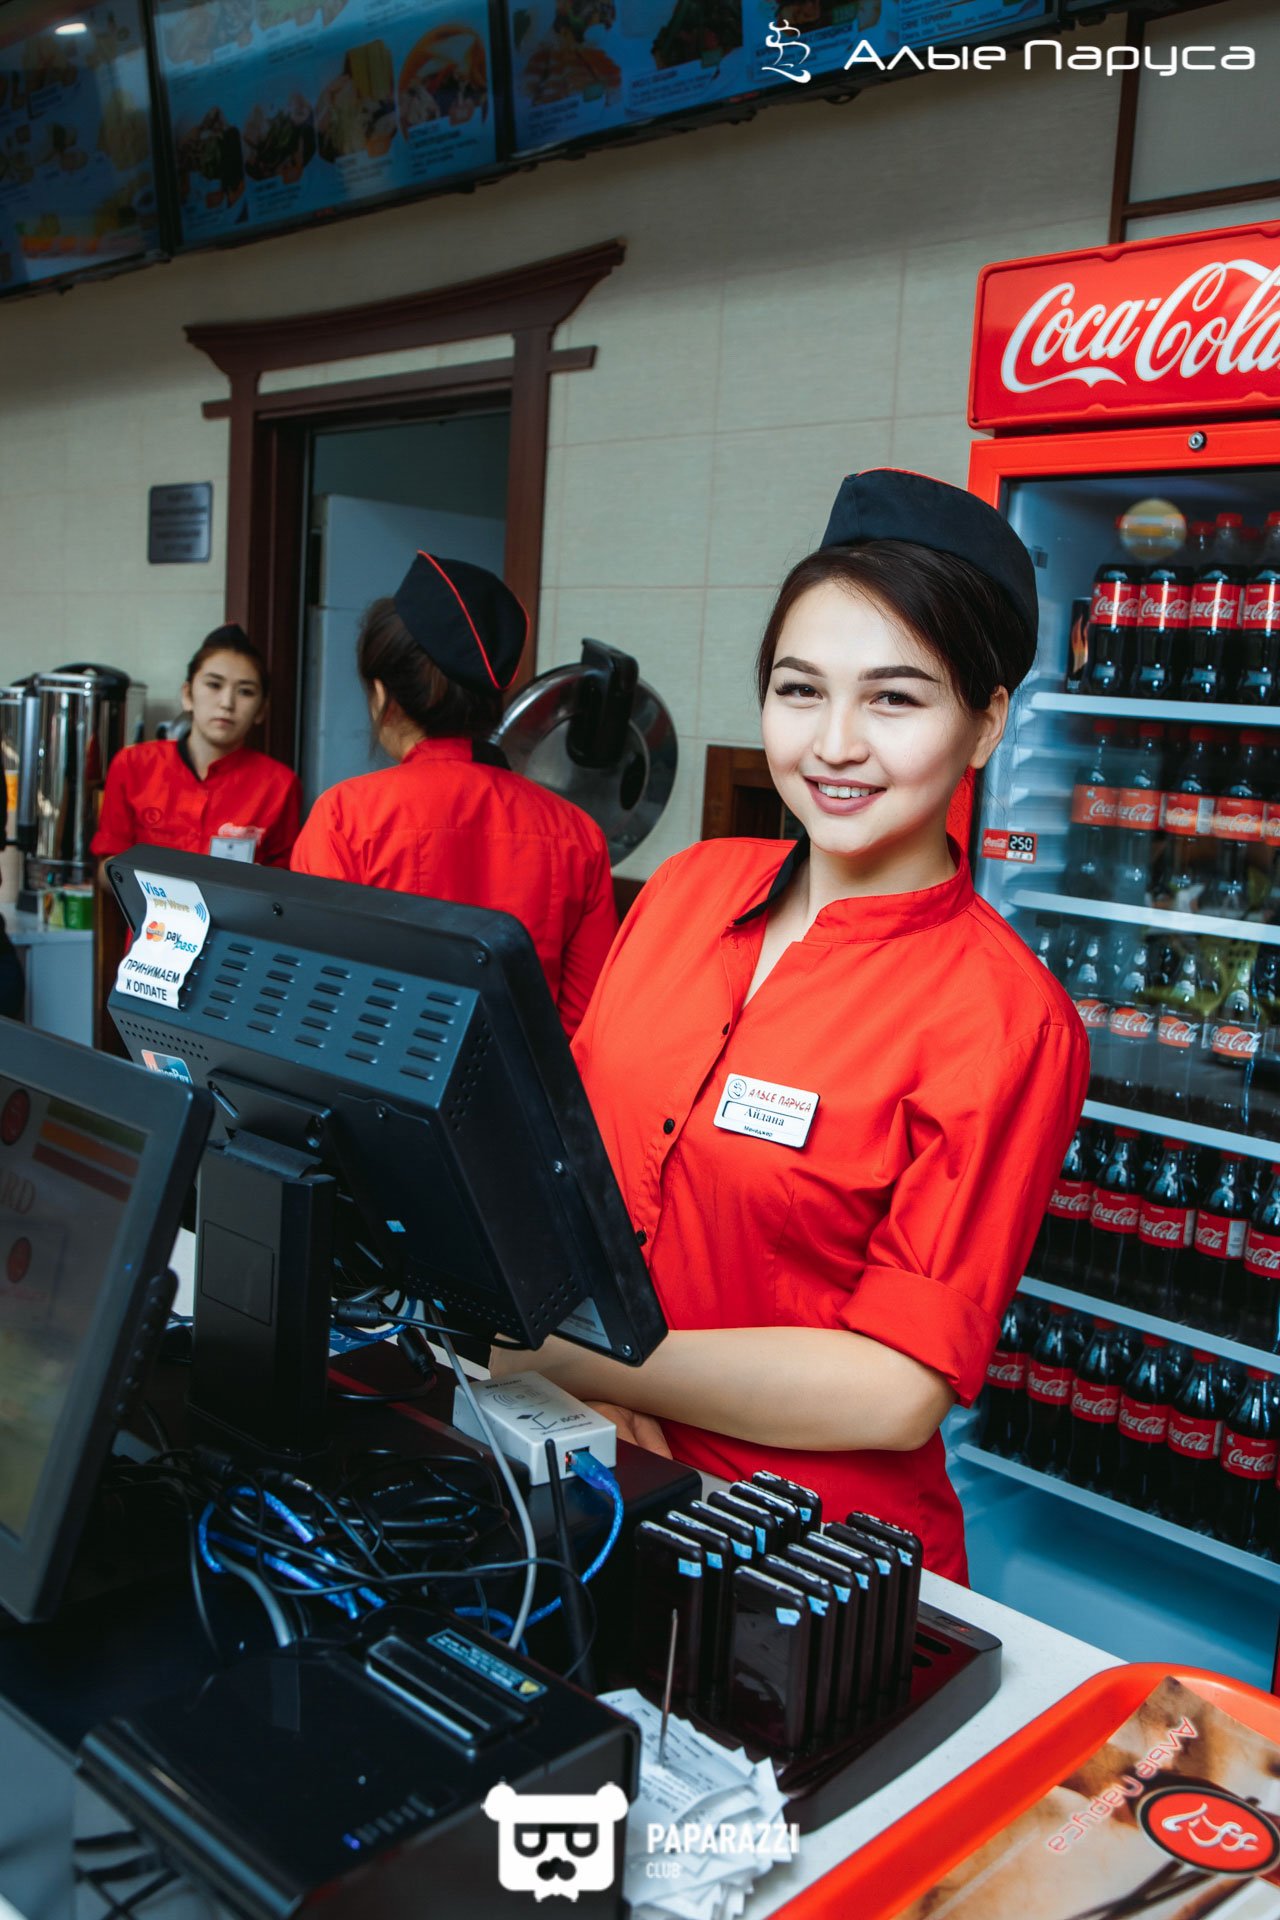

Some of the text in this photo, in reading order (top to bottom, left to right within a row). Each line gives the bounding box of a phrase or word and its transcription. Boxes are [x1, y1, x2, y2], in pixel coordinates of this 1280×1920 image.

[1001, 259, 1280, 393] Coca-Cola
[1009, 835, 1033, 851] 250
[141, 880, 167, 898] Visa
[164, 930, 182, 943] pay
[172, 938, 199, 954] pass
[124, 958, 181, 984] ПРИНИМАЕМ
[126, 979, 168, 1002] К ОПЛАТЕ
[1048, 1717, 1198, 1853] Алые Паруса
